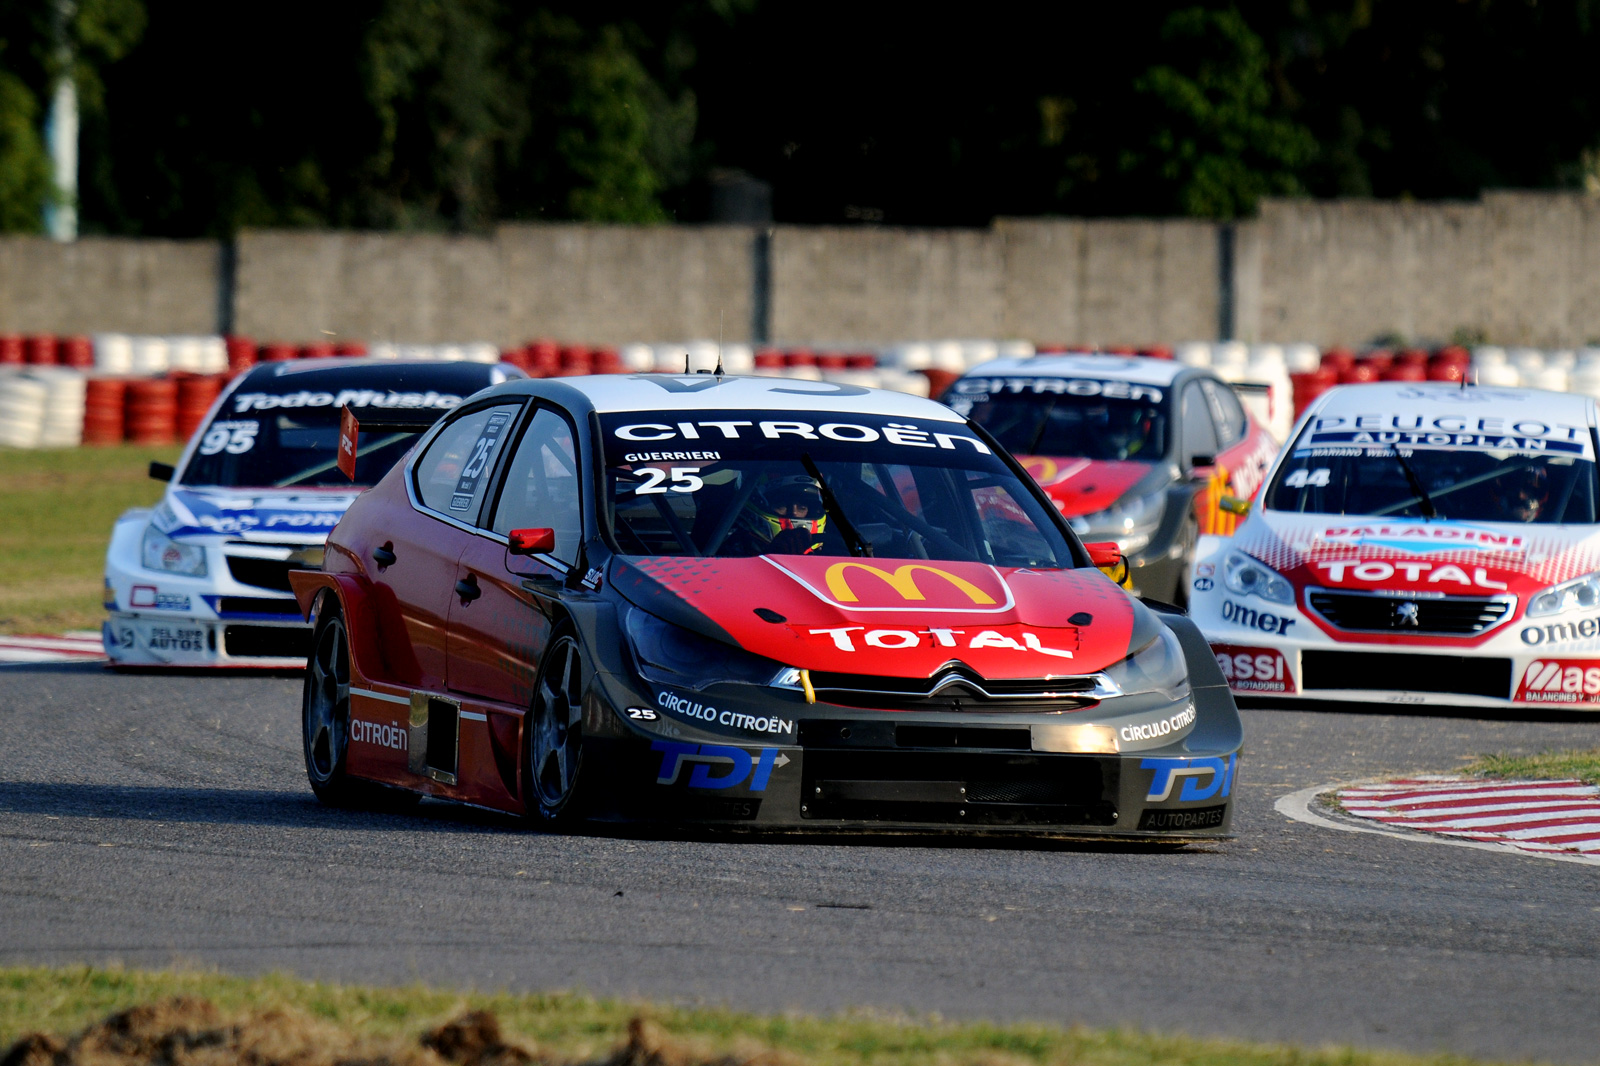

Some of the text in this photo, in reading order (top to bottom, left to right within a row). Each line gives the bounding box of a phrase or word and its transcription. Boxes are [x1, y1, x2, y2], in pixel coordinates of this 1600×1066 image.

[1314, 414, 1588, 441] PEUGEOT
[200, 429, 259, 456] 95
[1311, 447, 1363, 458] MARIANO
[1352, 432, 1548, 451] AUTOPLAN
[462, 437, 496, 479] 25
[624, 451, 721, 463] GUERRIERI
[632, 467, 704, 495] 25
[1284, 466, 1332, 489] 44
[1324, 526, 1524, 547] PALADINI
[1317, 560, 1508, 591] TOTAL
[149, 637, 204, 652] AUTOS
[808, 626, 1074, 659] TOTAL
[1526, 691, 1577, 703] BALANCINES
[627, 708, 657, 720] 25
[658, 691, 793, 734] CÍRCULO CITROËN
[1121, 720, 1171, 742] CÍRCULO
[650, 740, 780, 792] TDI
[1140, 752, 1238, 802] TDI
[1147, 809, 1223, 827] AUTOPARTES
